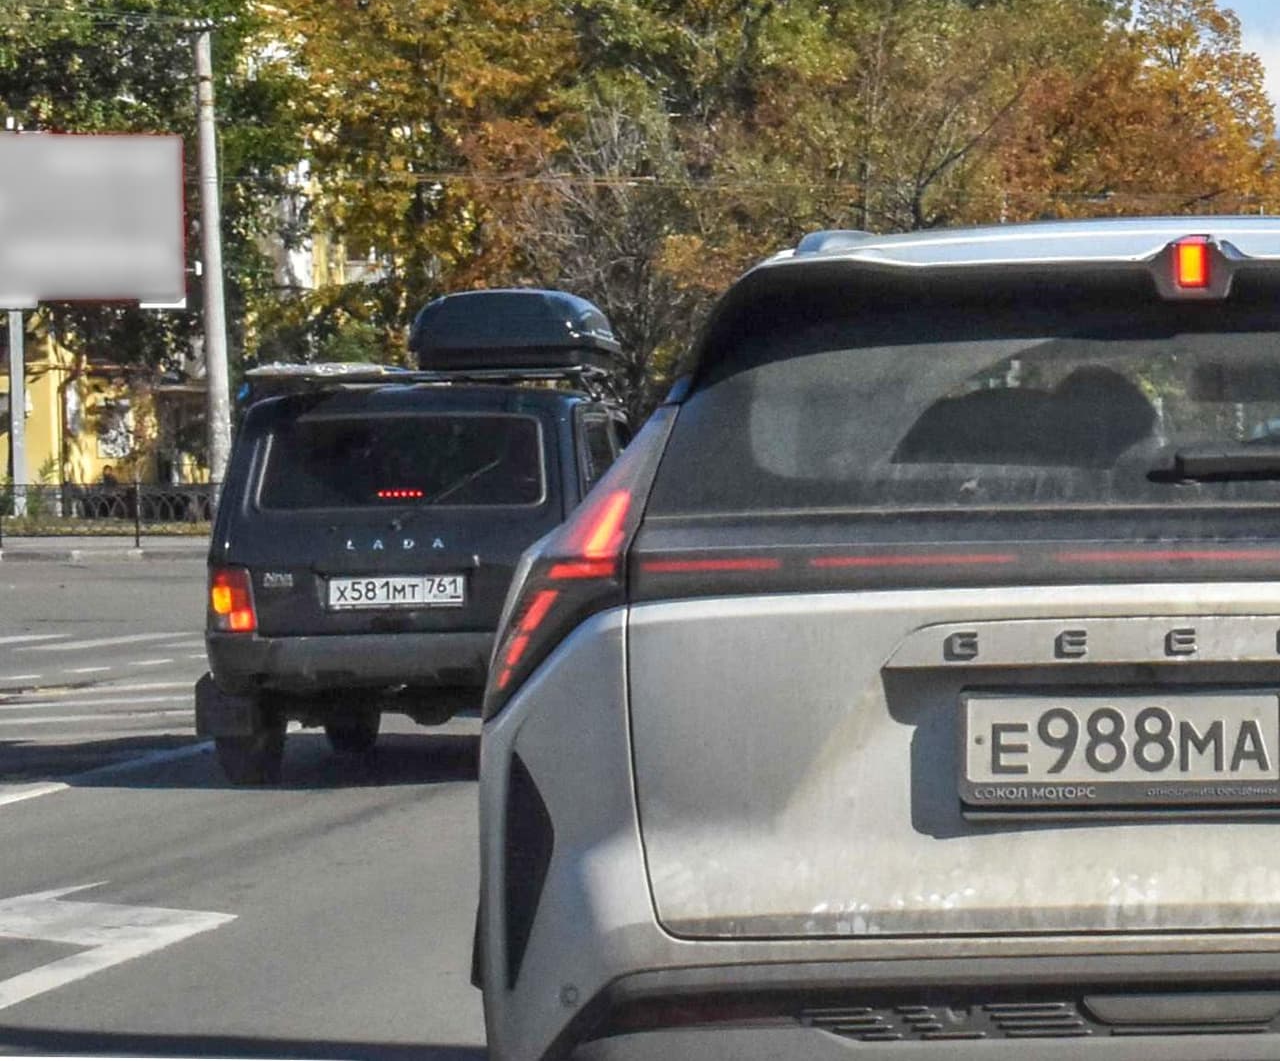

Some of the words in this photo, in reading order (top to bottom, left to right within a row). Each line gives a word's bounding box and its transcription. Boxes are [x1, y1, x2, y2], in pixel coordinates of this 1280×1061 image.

[346, 538, 445, 550] LADA
[426, 578, 458, 595] 761
[991, 706, 1270, 774] Е988МА
[975, 787, 1028, 799] СОКОЛ
[1032, 787, 1097, 799] МОТОРС
